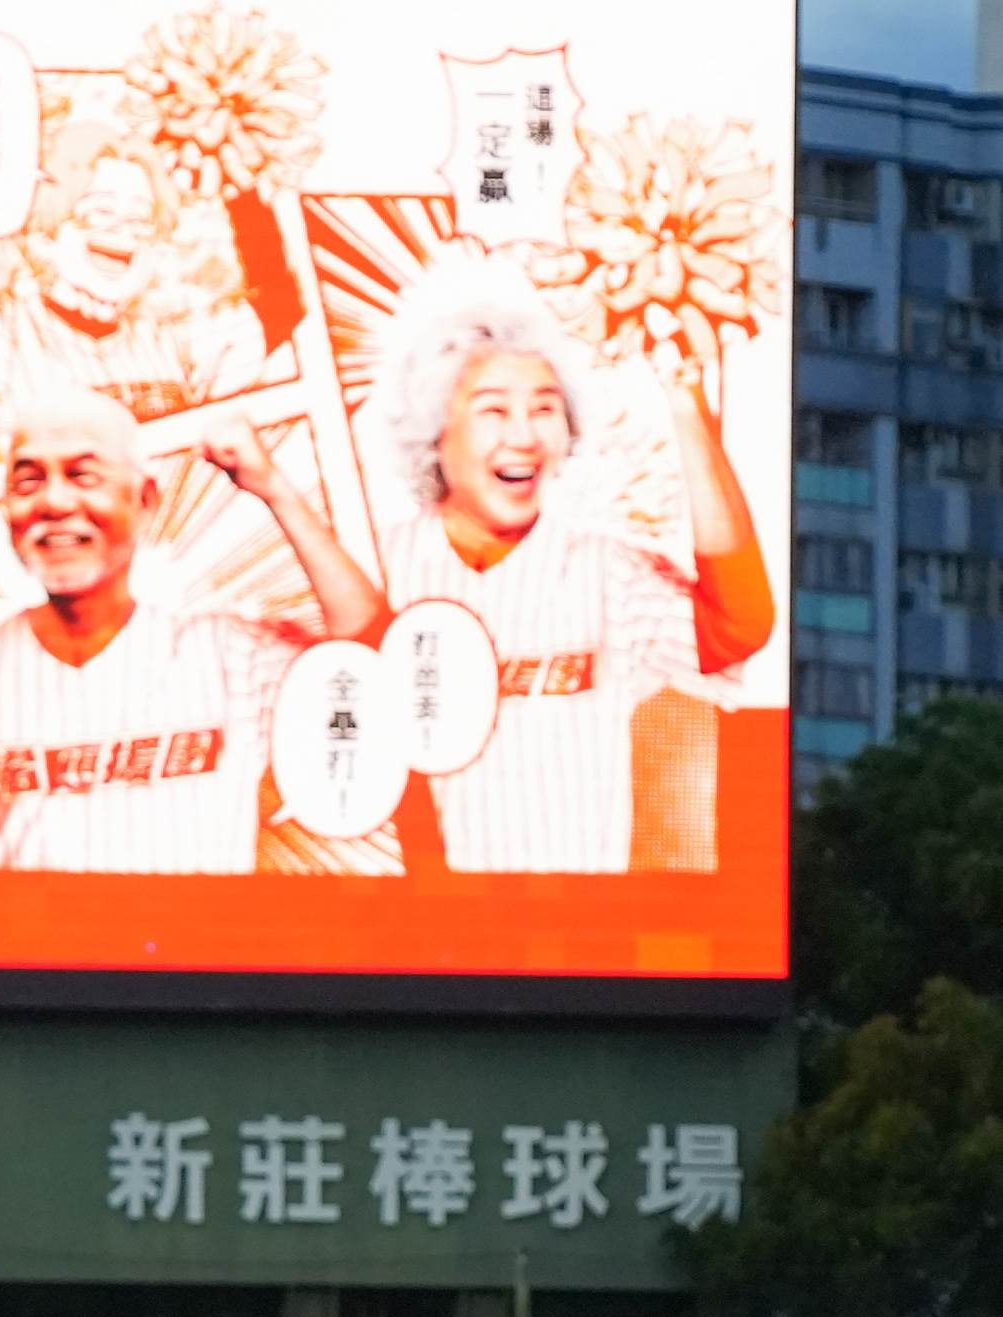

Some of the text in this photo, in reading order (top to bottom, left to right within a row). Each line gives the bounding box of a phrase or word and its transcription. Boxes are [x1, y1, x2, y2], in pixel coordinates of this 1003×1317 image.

[108, 1111, 743, 1230] 新莊棒球場
